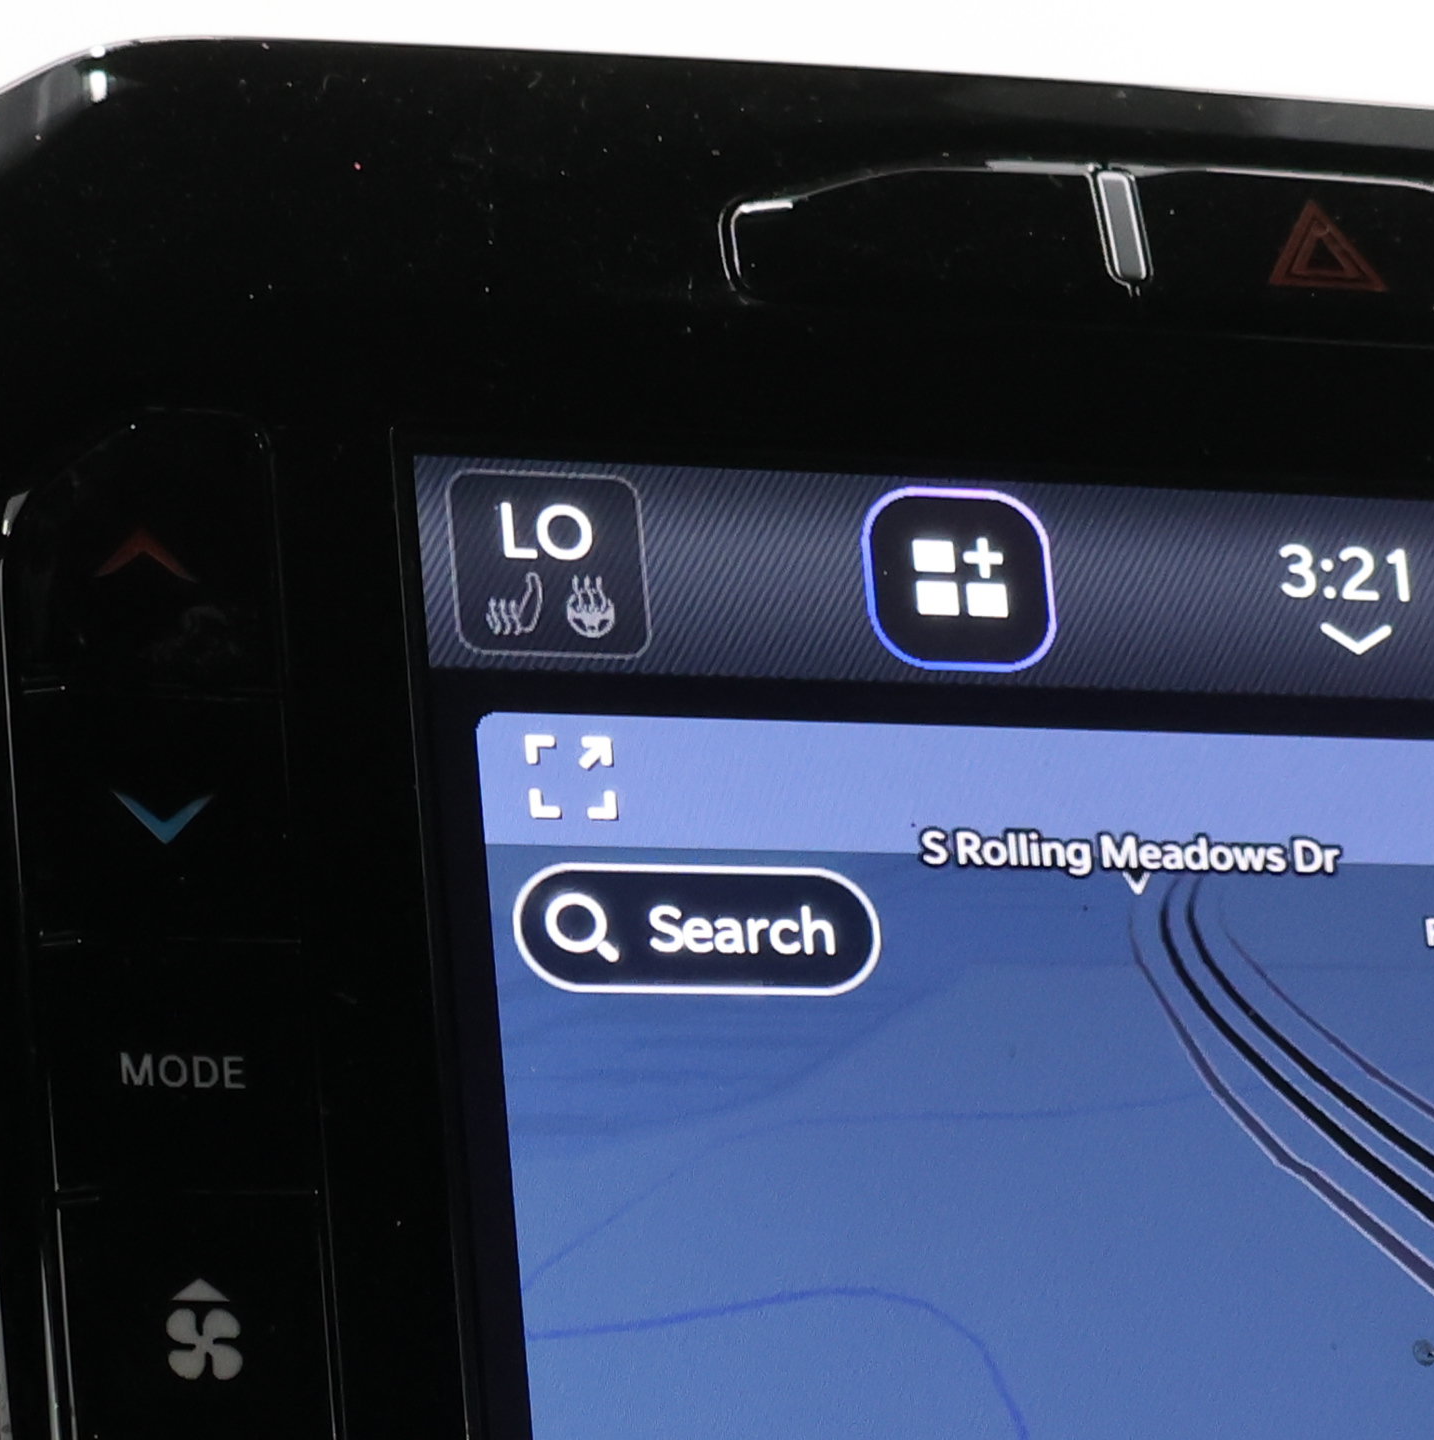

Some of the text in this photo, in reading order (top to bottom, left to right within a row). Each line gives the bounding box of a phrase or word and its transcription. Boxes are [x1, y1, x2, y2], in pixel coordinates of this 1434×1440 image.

[501, 502, 592, 560] LO
[1280, 544, 1410, 601] 3:21
[923, 831, 1338, 874] S Rolling Meadows Dr
[649, 905, 835, 954] Search
[121, 1053, 244, 1088] MODE
